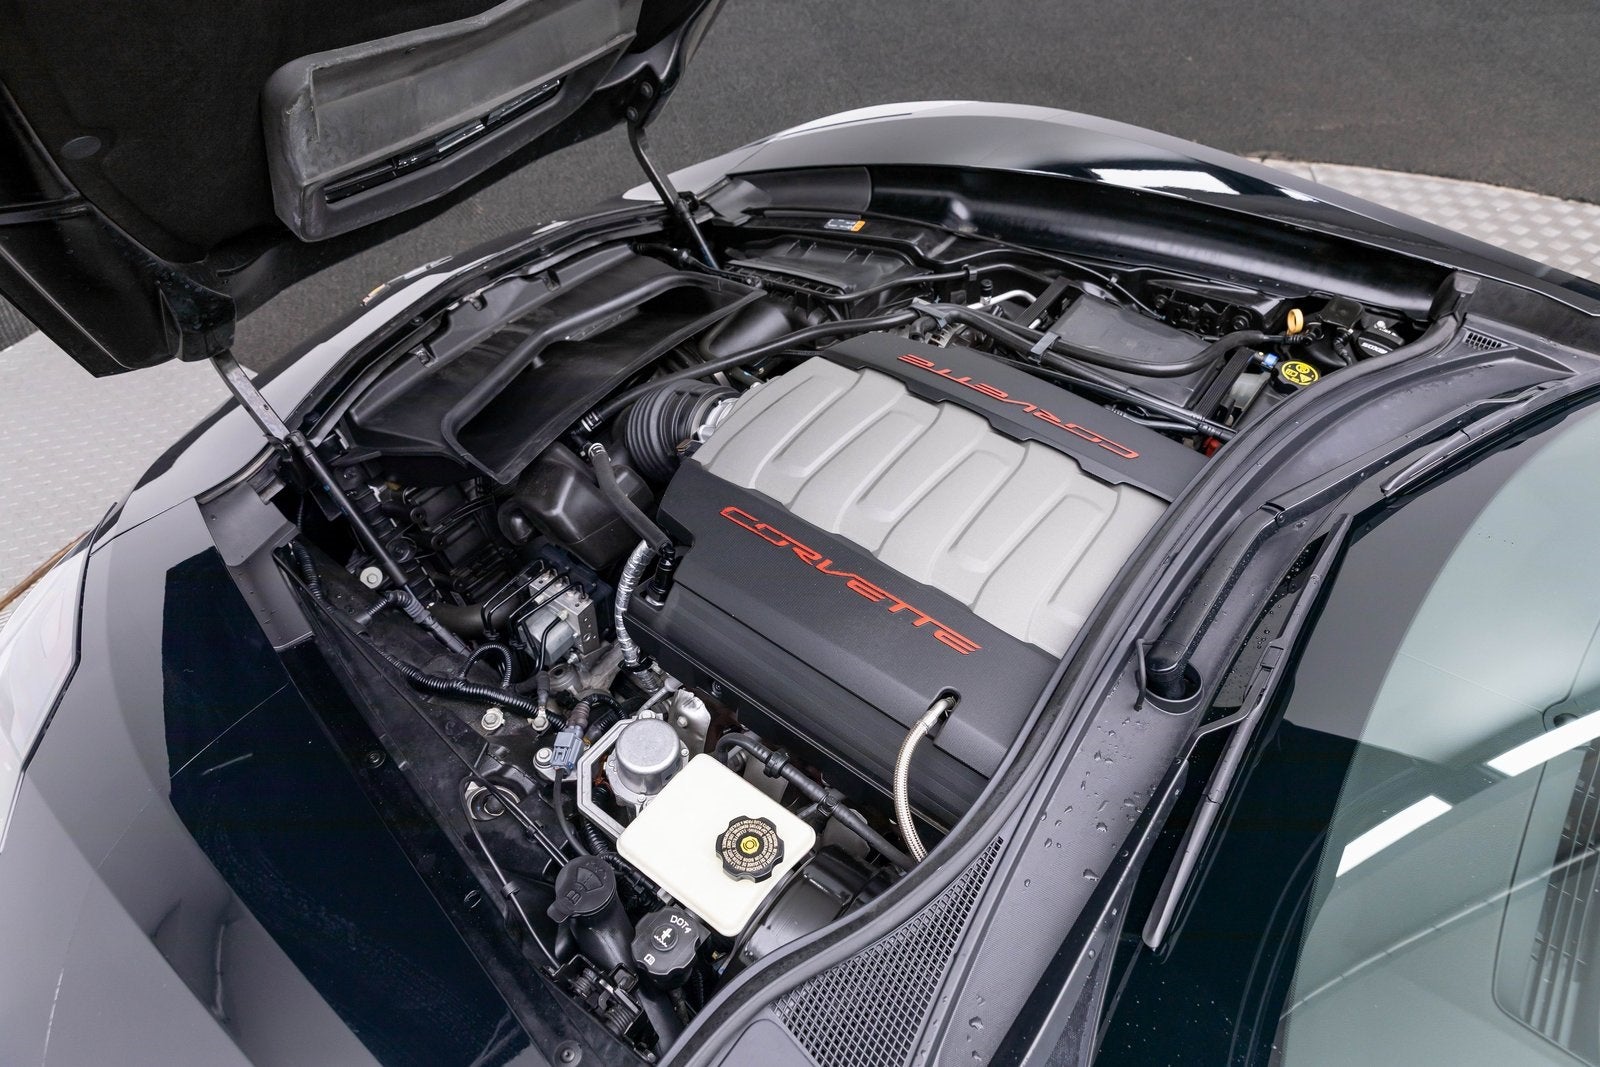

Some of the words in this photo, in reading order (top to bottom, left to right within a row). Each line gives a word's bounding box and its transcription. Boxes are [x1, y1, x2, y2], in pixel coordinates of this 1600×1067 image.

[897, 354, 1140, 459] CORVETTE
[720, 506, 982, 655] CORVETTE
[670, 914, 692, 934] DOT4
